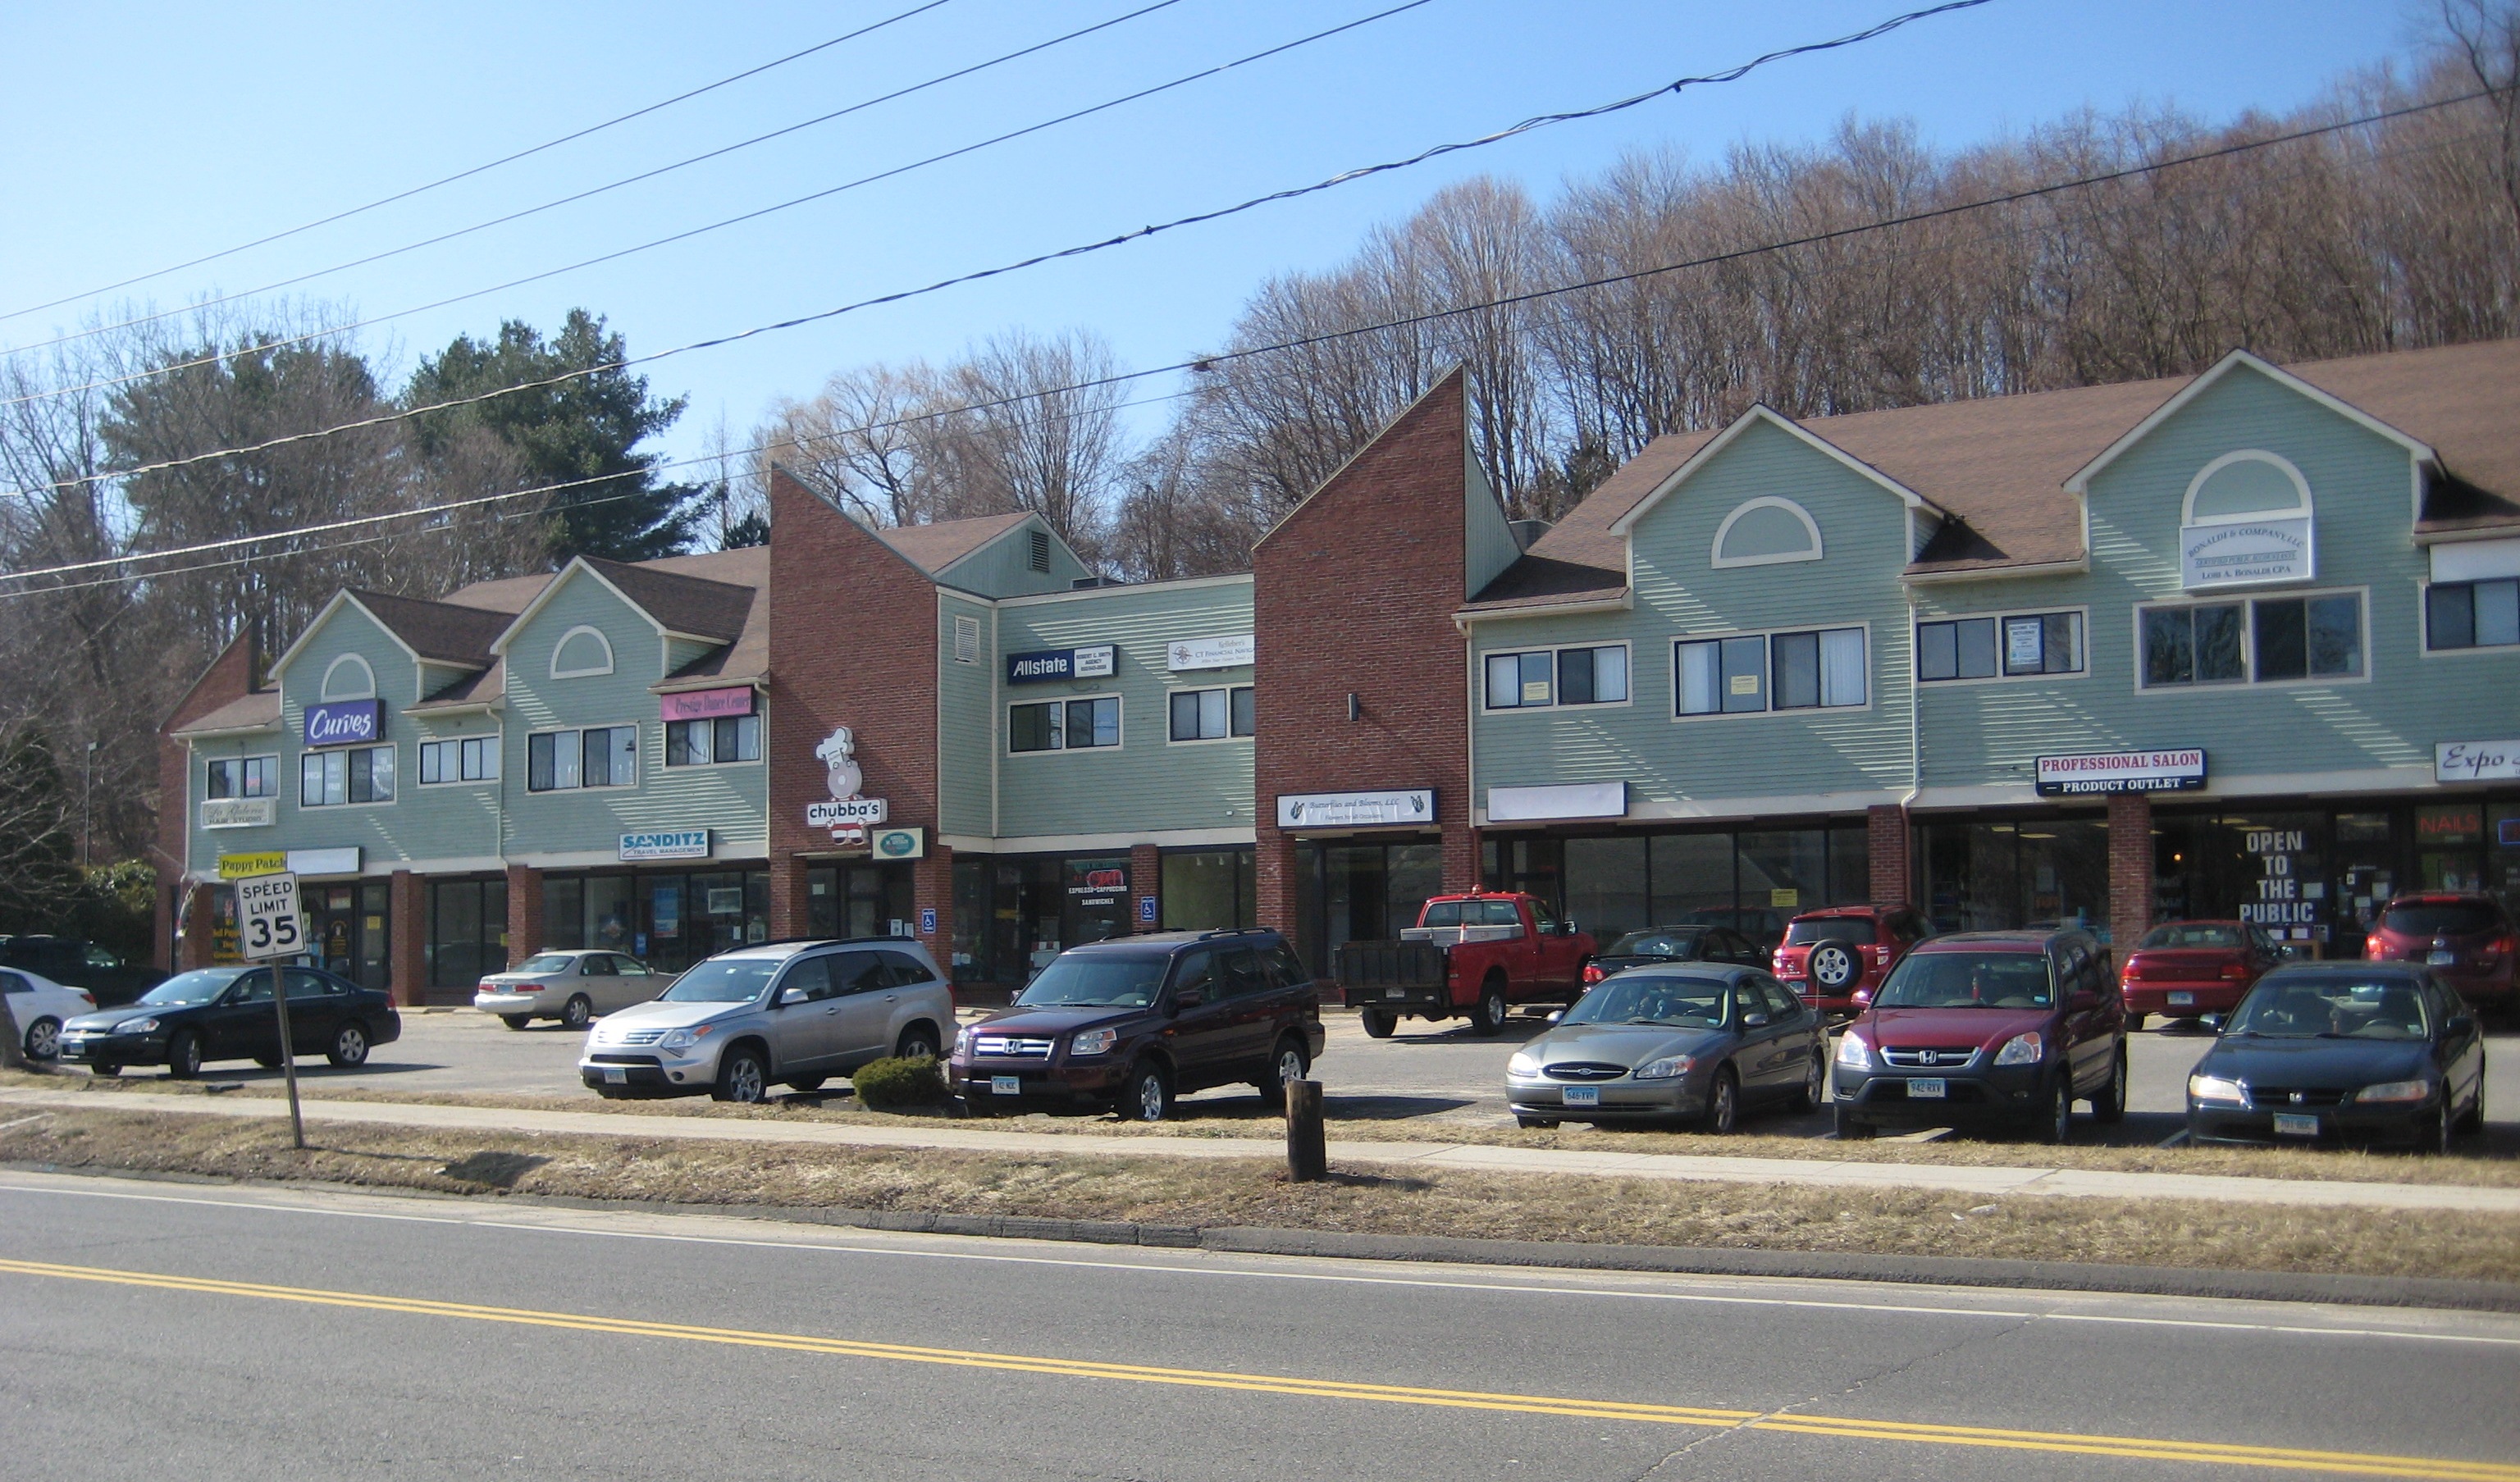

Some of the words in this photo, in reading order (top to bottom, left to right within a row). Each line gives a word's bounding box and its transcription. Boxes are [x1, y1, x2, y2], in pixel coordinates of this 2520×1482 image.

[2188, 531, 2227, 558] BONALDI
[2230, 529, 2236, 537] &
[1013, 657, 1068, 677] Allstate
[309, 709, 372, 739] Curves
[2041, 755, 2148, 772] PROFESSIONAL
[2152, 752, 2200, 767] SALON
[2442, 744, 2505, 777] Expo
[2061, 780, 2125, 793] PRODUCT
[2127, 777, 2181, 790] OUTLET
[809, 802, 879, 819] chubba's
[1344, 799, 1357, 807] and
[2419, 814, 2478, 833] NAILS
[623, 832, 705, 849] SANDITZ
[2246, 830, 2303, 852] OPEN
[221, 860, 254, 872] Pappy
[2262, 855, 2288, 875] TO
[243, 882, 293, 900] SPEED
[2256, 878, 2296, 900] THE
[251, 899, 288, 915] LIMIT
[1081, 898, 1115, 906] SANDWICHES
[2239, 902, 2314, 923] PUBLIC
[250, 914, 298, 948] 35
